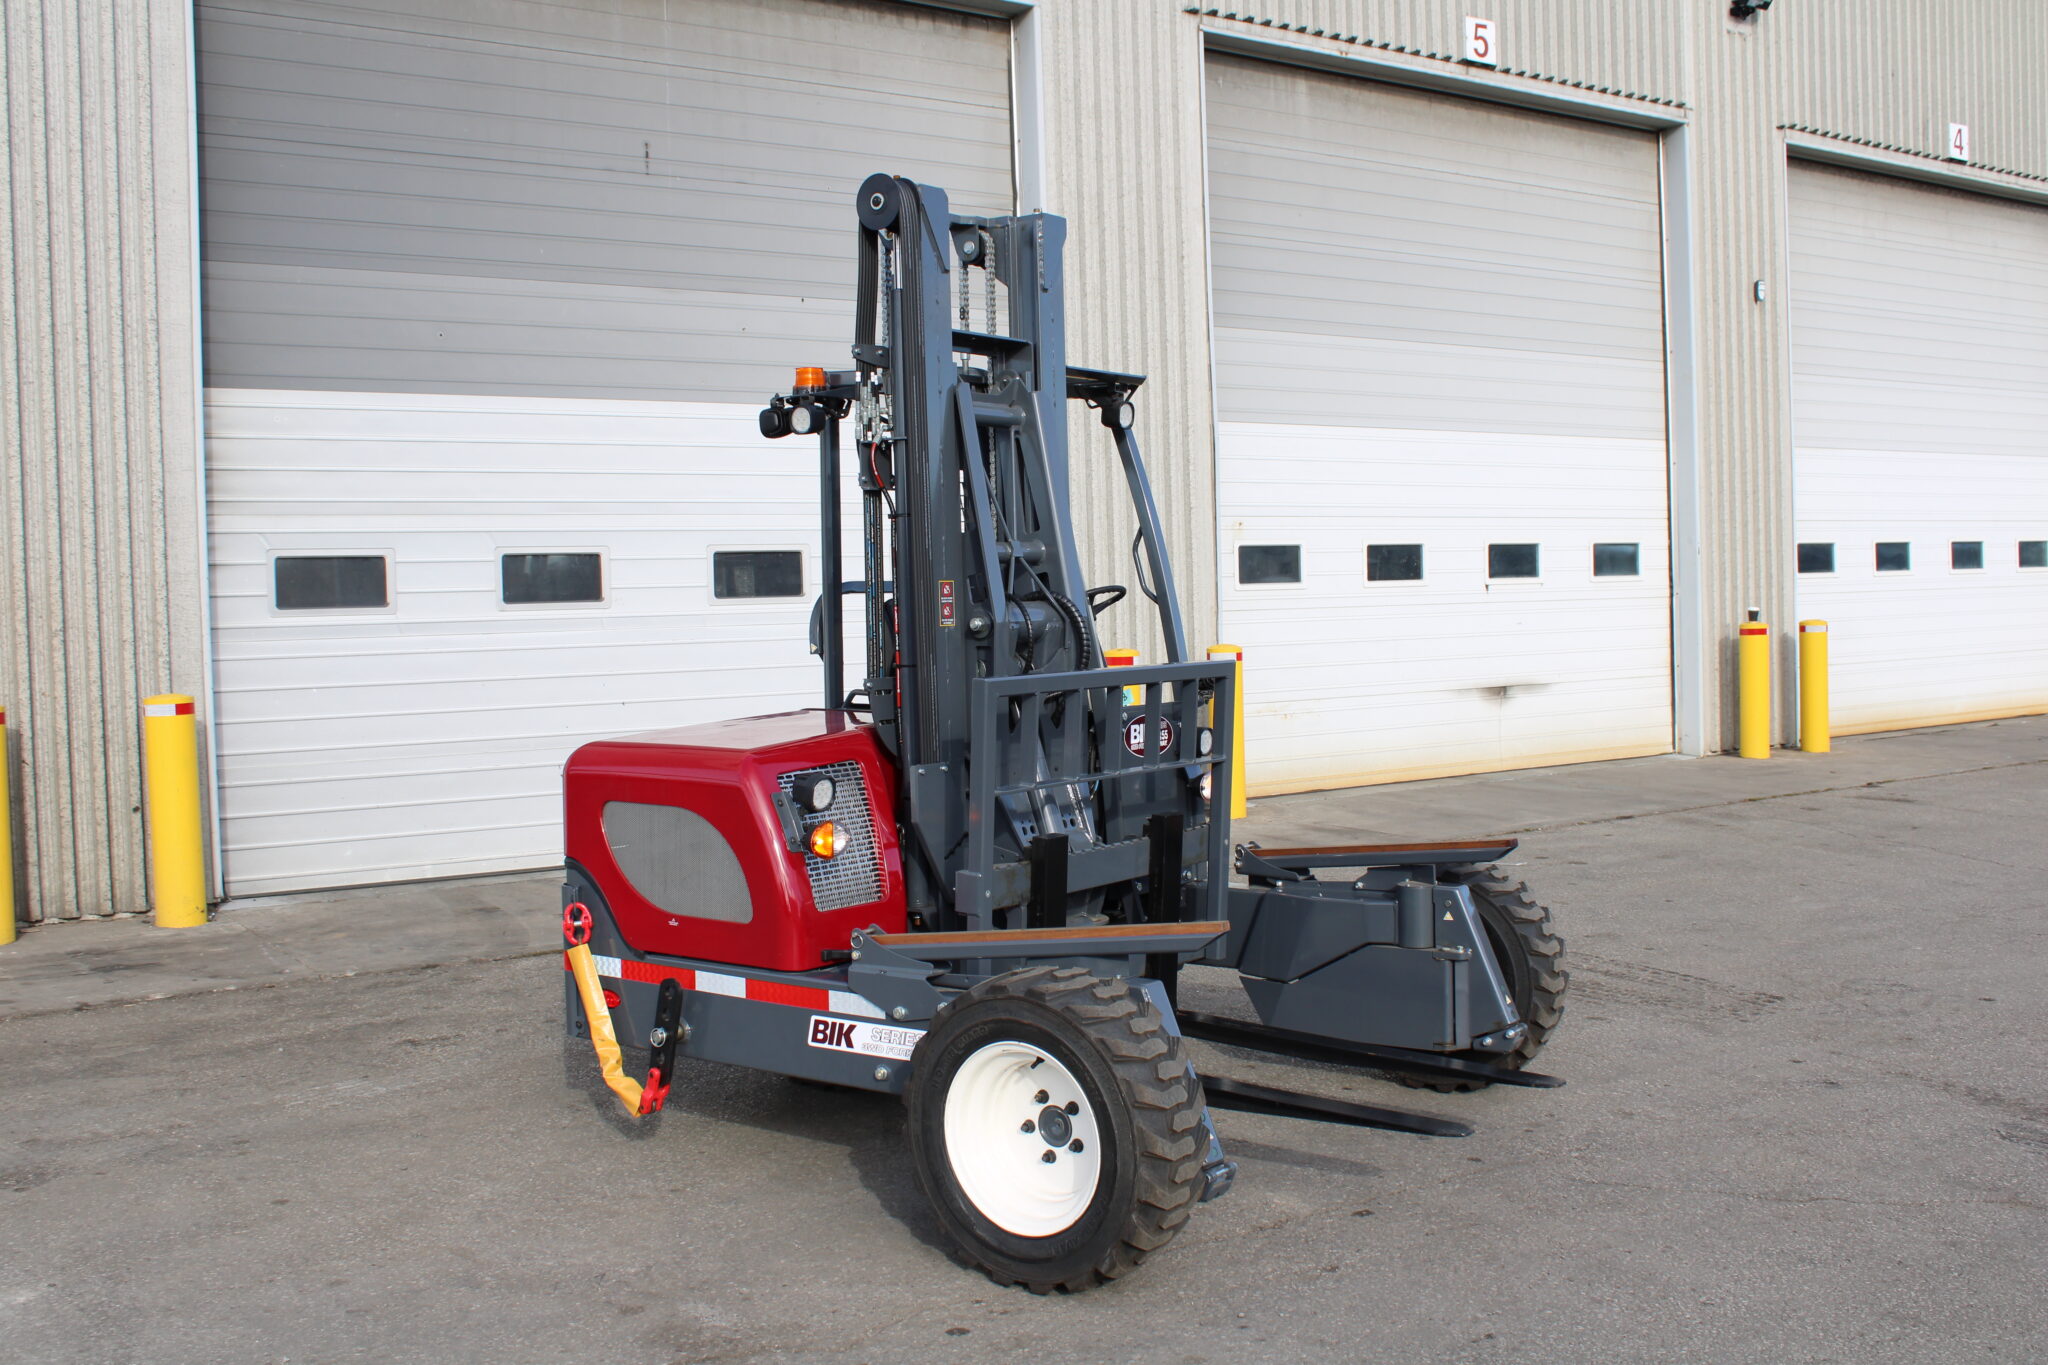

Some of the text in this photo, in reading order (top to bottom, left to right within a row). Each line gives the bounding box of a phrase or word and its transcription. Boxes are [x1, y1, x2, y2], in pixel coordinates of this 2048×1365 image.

[1473, 23, 1489, 58] 5
[1953, 128, 1964, 155] 4
[1130, 723, 1145, 744] BI
[811, 1019, 857, 1048] BIK
